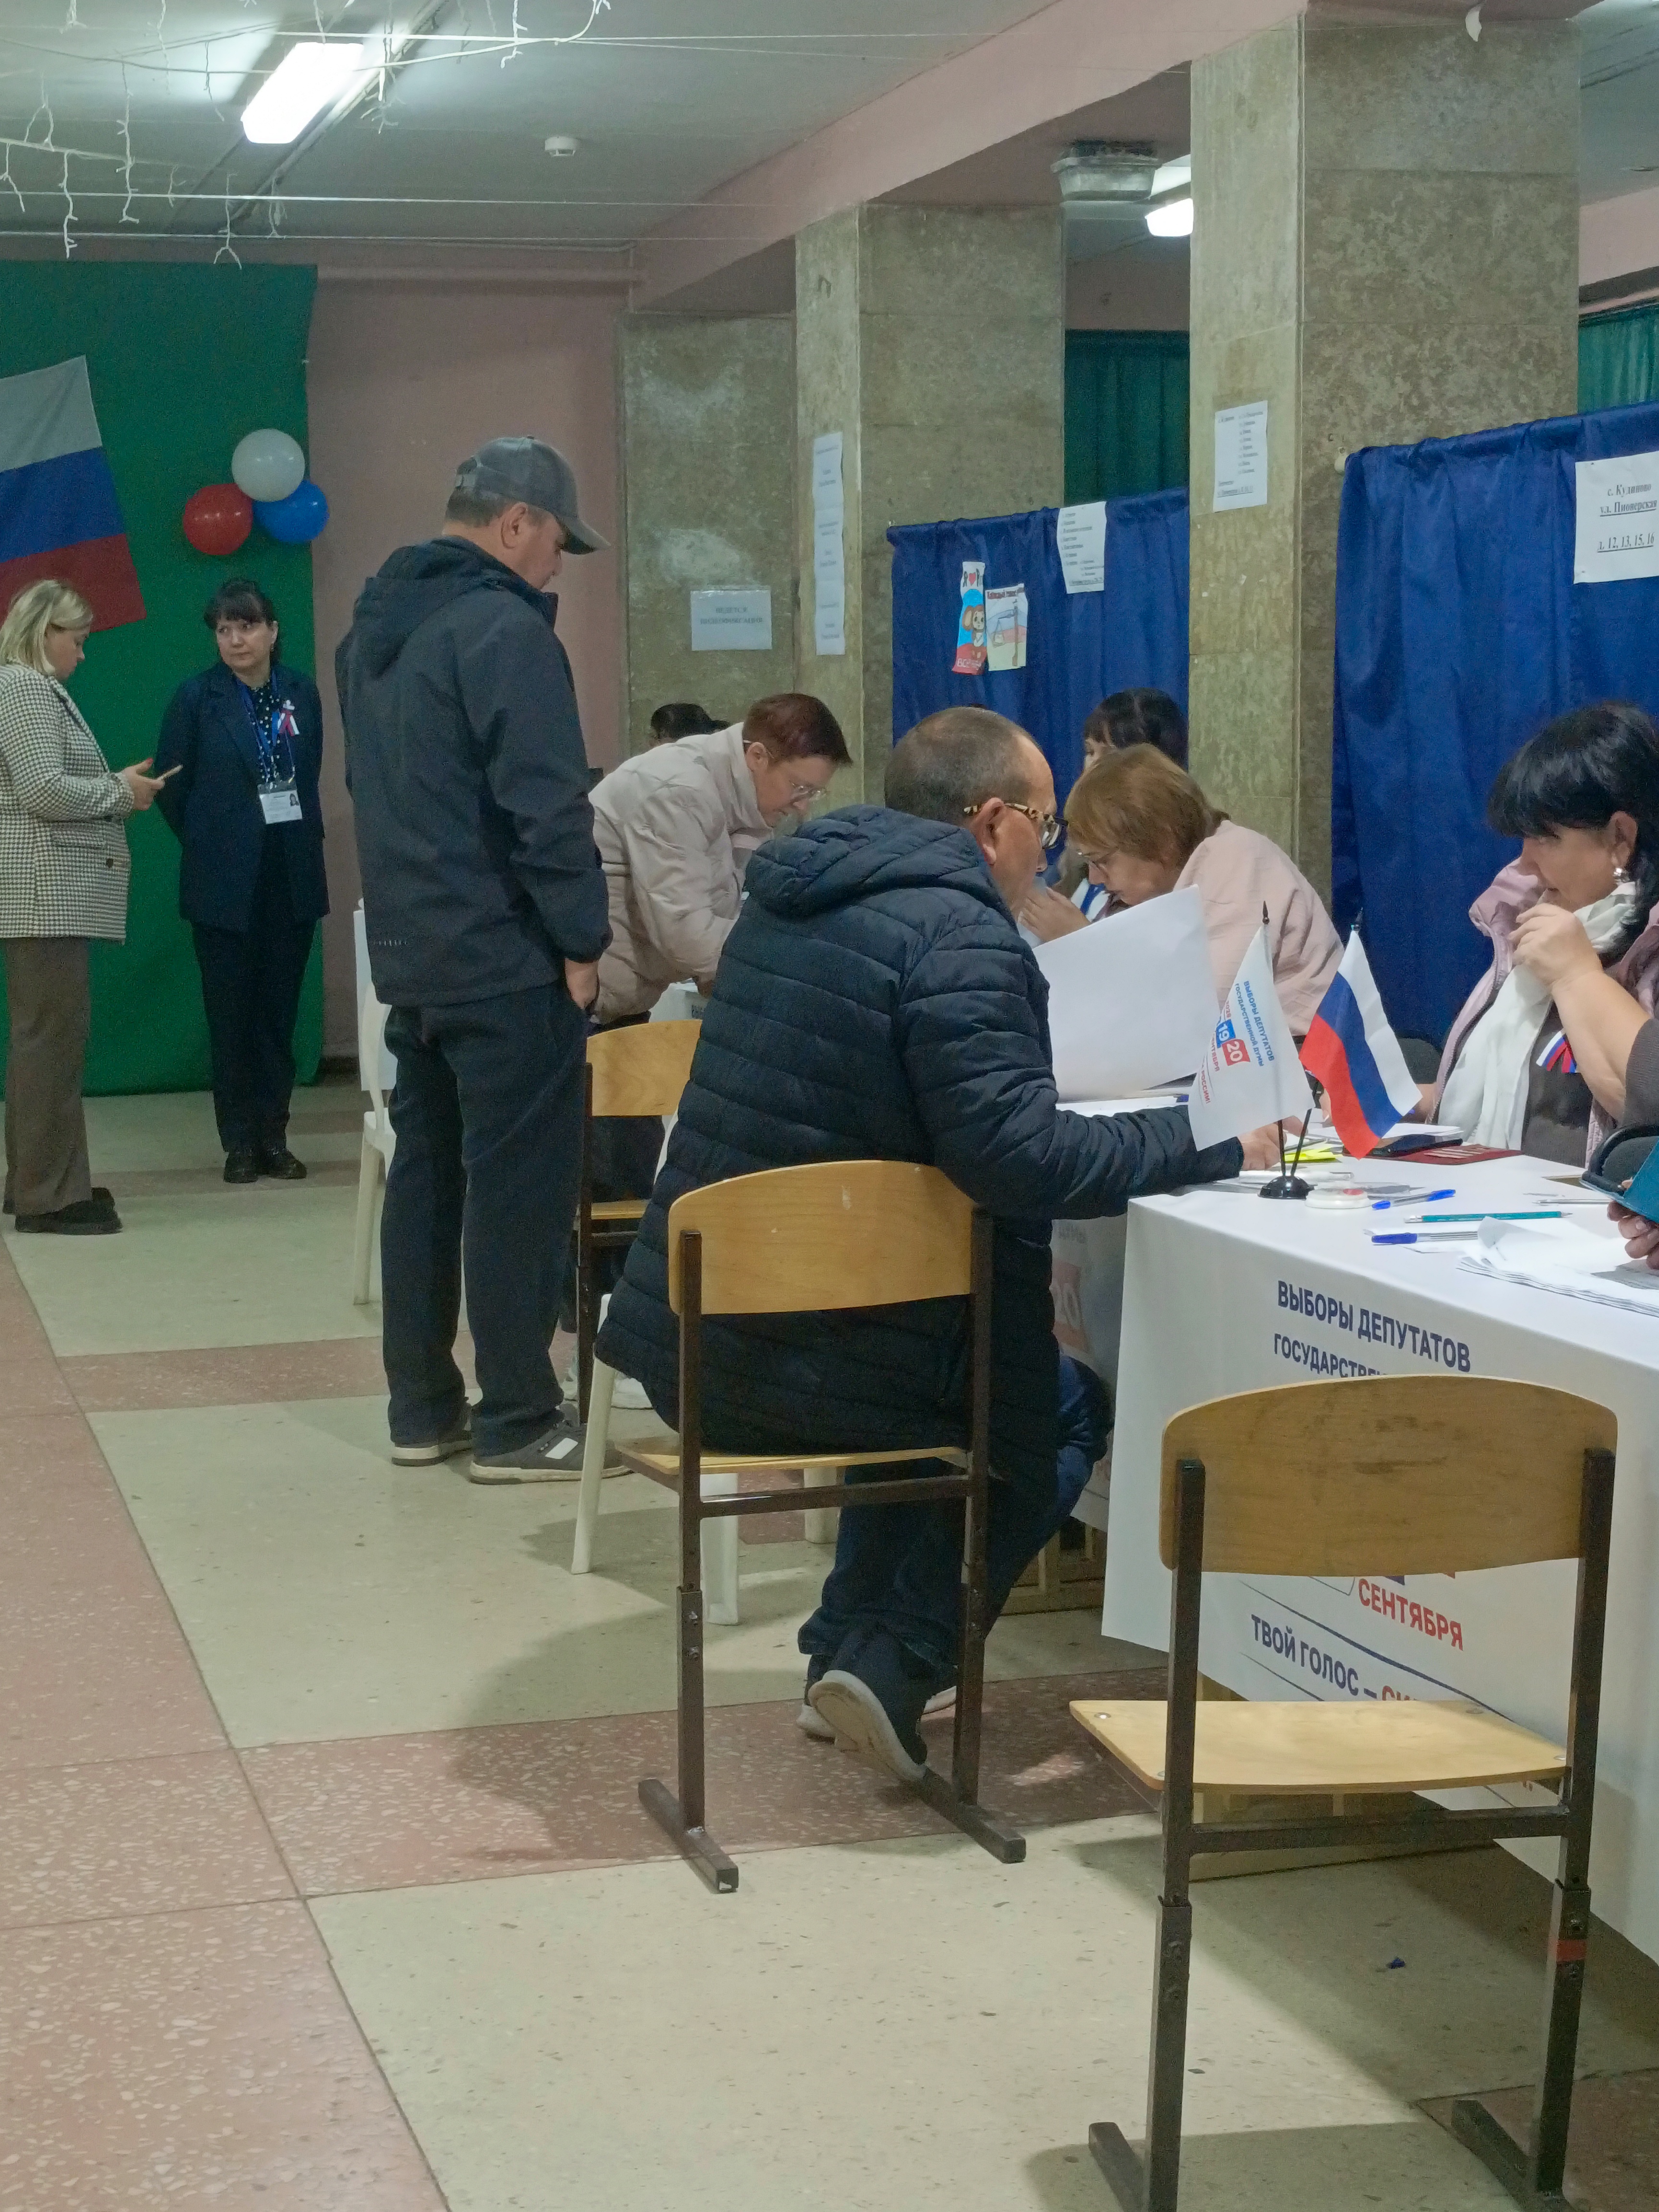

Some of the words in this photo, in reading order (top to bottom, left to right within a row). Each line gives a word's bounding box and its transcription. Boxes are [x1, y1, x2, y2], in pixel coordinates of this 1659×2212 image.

[1600, 505, 1611, 514] ул.
[1614, 500, 1657, 512] Пионерская
[1607, 488, 1613, 496] с.
[1647, 531, 1655, 545] 16
[1218, 1023, 1230, 1041] 19
[1235, 983, 1258, 1046] ГОСУДАРСТВЕННОЙ
[1253, 1047, 1264, 1067] ДУМЫ
[1244, 981, 1259, 1015] ВЫБОРЫ
[1254, 1016, 1274, 1061] ДЕПУТАТОВ
[1226, 1041, 1243, 1062] 20
[1278, 1280, 1353, 1332] ВЫБОРЫ
[1358, 1308, 1470, 1372] ДЕПУТАТОВ
[1358, 1578, 1463, 1651] СЕНТЯБРЯ
[1251, 1614, 1296, 1662] ТВОЙ
[1300, 1641, 1359, 1696] ГОЛОС
